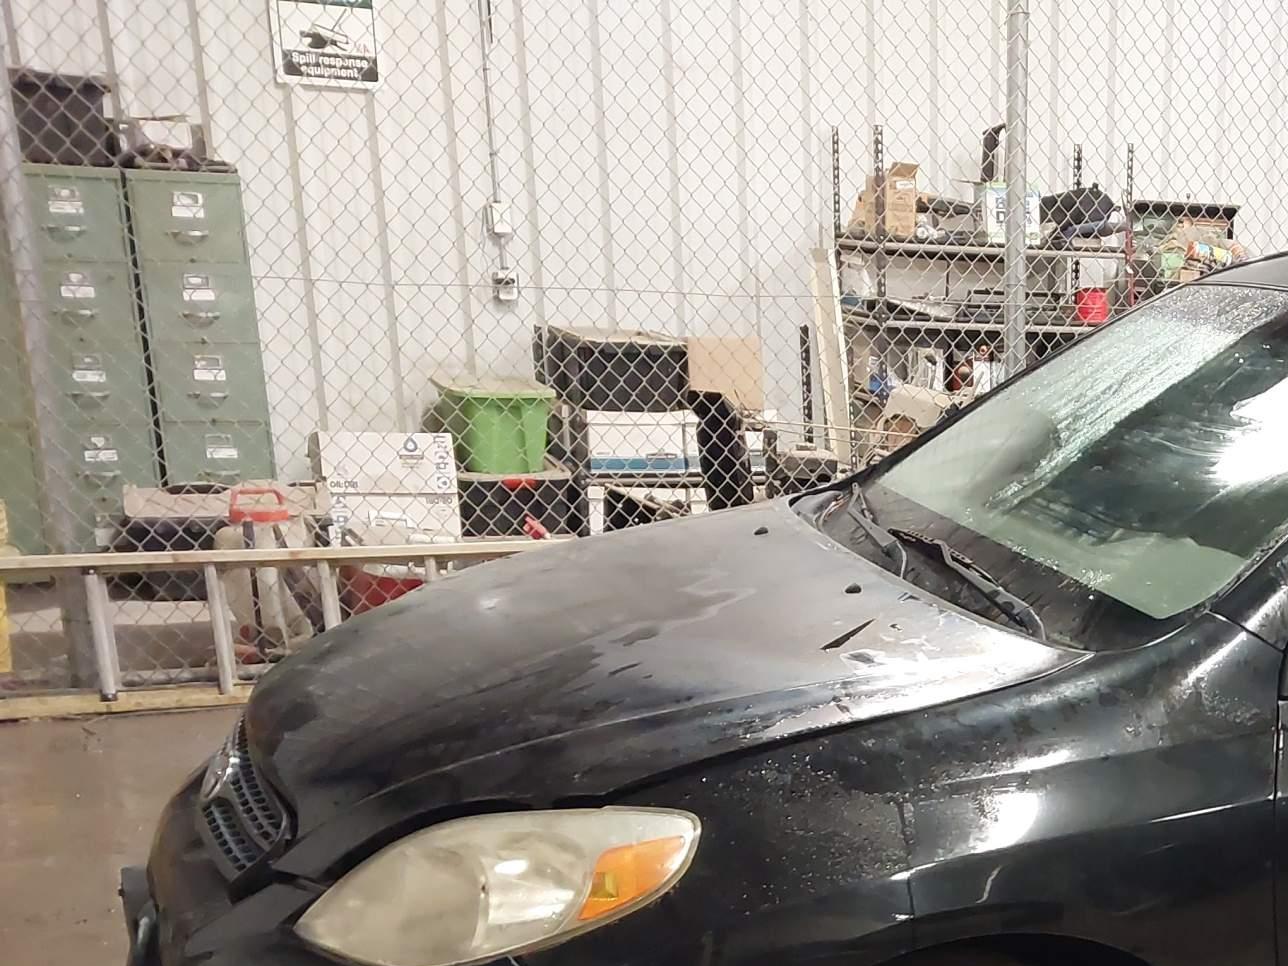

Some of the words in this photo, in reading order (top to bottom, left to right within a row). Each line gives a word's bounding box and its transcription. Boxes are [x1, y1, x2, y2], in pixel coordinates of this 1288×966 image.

[292, 51, 316, 64] Spill
[318, 55, 369, 68] response
[300, 65, 359, 78] equipment
